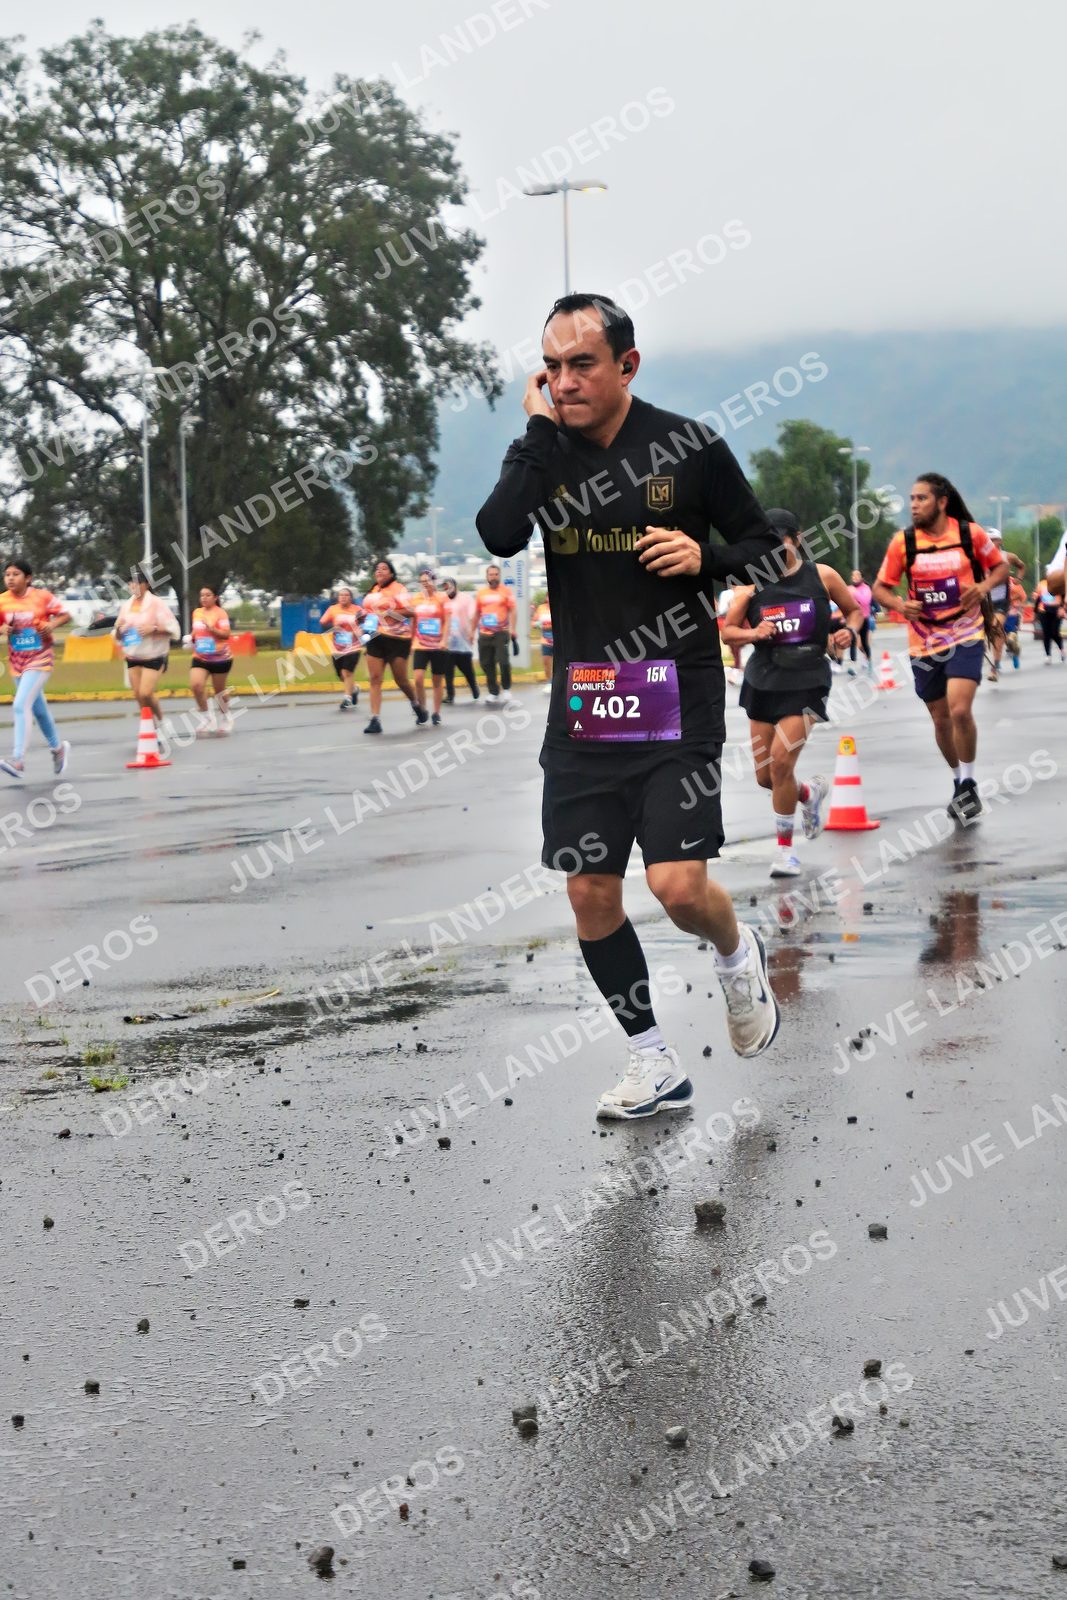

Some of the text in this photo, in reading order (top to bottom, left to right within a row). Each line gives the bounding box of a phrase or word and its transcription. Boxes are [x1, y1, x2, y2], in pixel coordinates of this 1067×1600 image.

[583, 526, 643, 552] YouTub
[924, 591, 947, 603] 520
[775, 618, 800, 633] 167
[592, 695, 641, 719] 402
